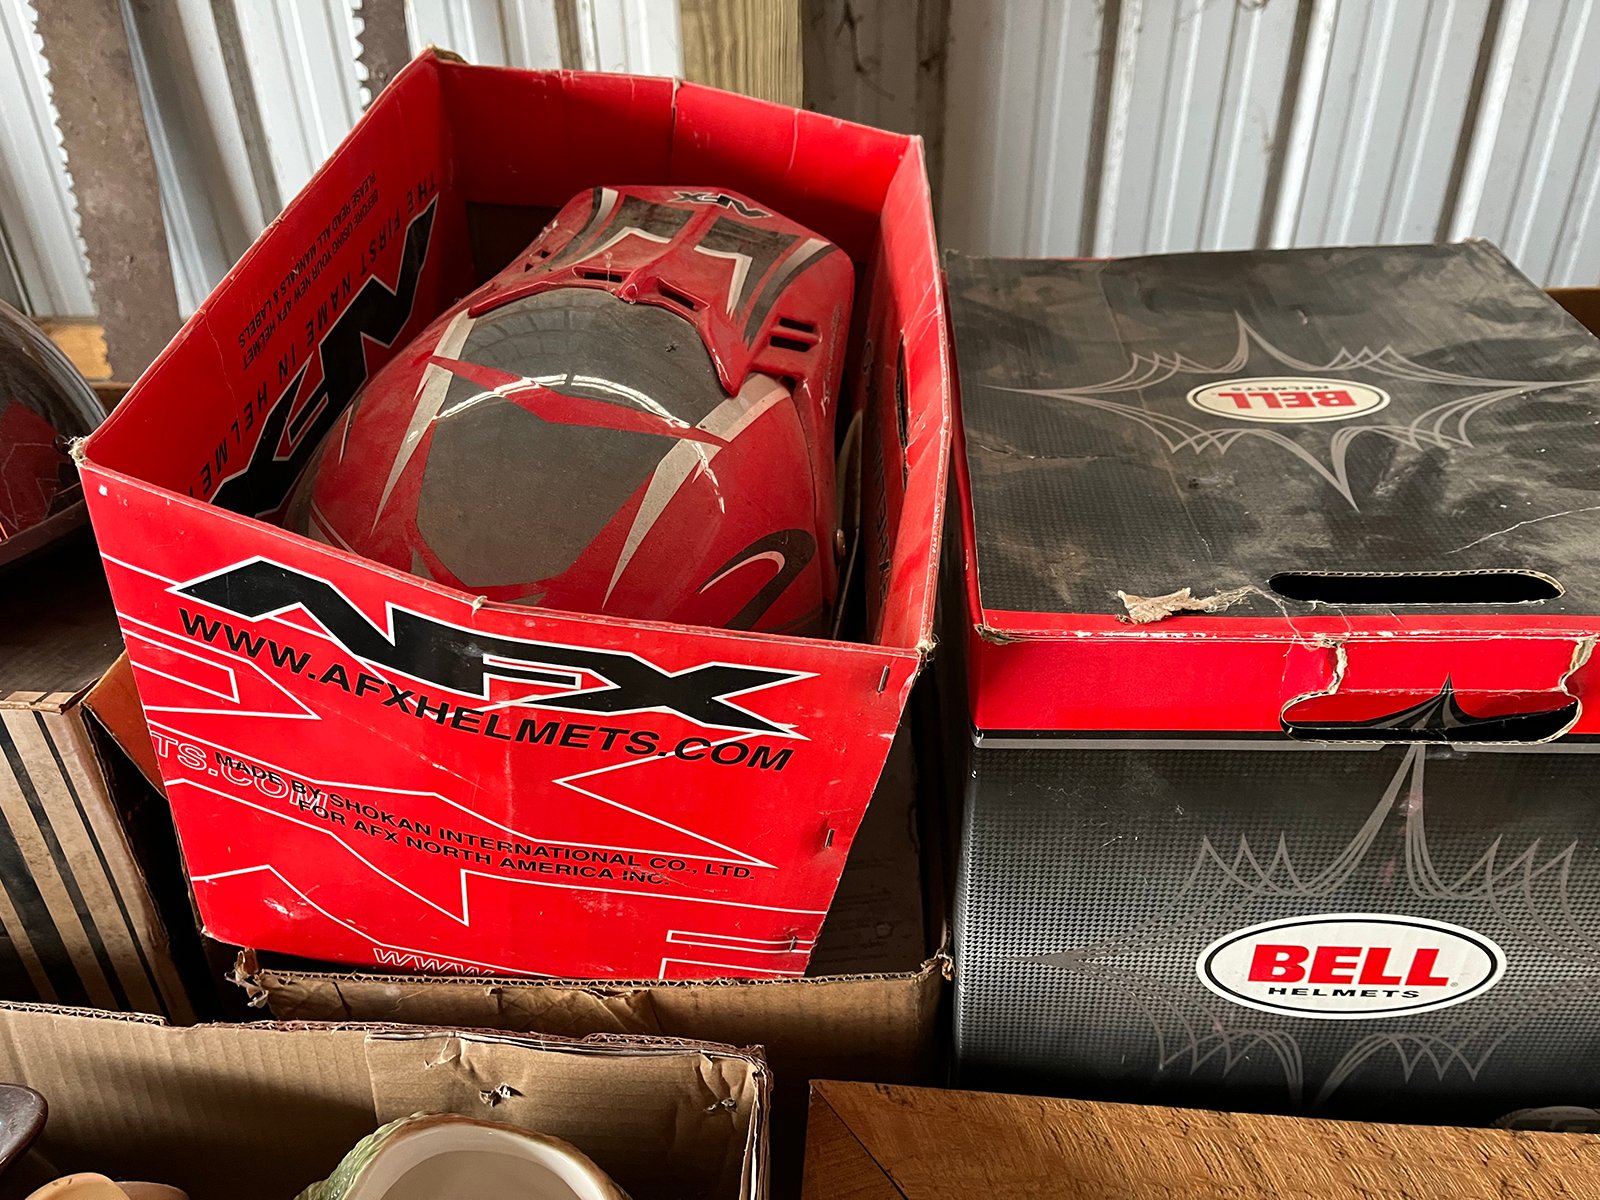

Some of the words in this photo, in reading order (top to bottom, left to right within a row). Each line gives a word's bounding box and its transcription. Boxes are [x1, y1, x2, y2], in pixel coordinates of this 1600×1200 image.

[407, 170, 436, 214] THE
[667, 189, 773, 219] AFX
[317, 224, 331, 248] ALL
[331, 200, 352, 232] READ
[311, 248, 333, 280] YOUR
[361, 208, 401, 277] FIRST
[276, 297, 292, 322] AFX
[294, 275, 312, 304] NEW
[306, 272, 351, 347] NAME
[238, 299, 272, 349] LABELS
[243, 318, 276, 370] HELMET
[278, 343, 296, 384] IN
[1218, 390, 1357, 409] BELL
[164, 555, 821, 741] AFX
[178, 608, 794, 772] WWW.AFXHELMETS.COM
[214, 752, 282, 786] MADE
[290, 779, 321, 798] BY
[330, 793, 431, 836] SHOKAN
[439, 828, 641, 867] INTERNATIONAL
[649, 857, 697, 875] CO.,
[705, 863, 755, 880] LTD.
[299, 800, 346, 826] FOR
[353, 820, 399, 844] AFX
[406, 836, 491, 865] NORTH
[500, 857, 614, 880] AMERICA
[622, 870, 670, 886] INC.
[1247, 944, 1450, 987] BELL
[1268, 987, 1420, 998] HELMETS
